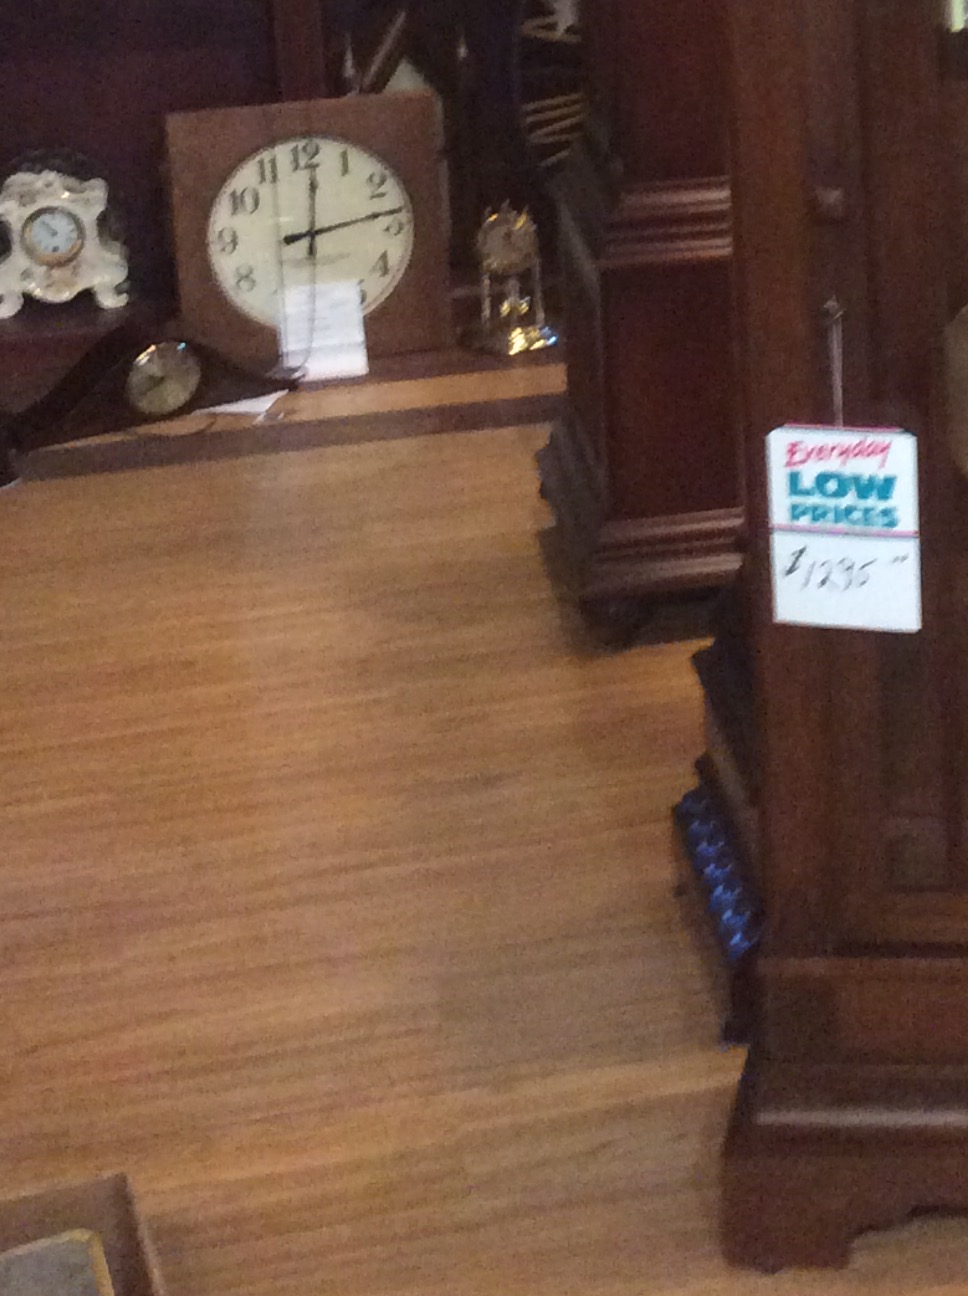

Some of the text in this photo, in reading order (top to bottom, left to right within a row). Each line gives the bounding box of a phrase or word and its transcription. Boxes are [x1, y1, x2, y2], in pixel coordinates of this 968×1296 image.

[256, 155, 278, 184] 11
[289, 140, 320, 172] 12
[339, 149, 349, 177] 1
[367, 171, 388, 200] 2
[229, 186, 260, 216] 10
[217, 226, 238, 255] 9
[235, 262, 256, 293] 8
[370, 250, 389, 277] 4
[784, 437, 892, 469] Everyday
[788, 471, 898, 501] LOW
[790, 503, 899, 528] PRICES
